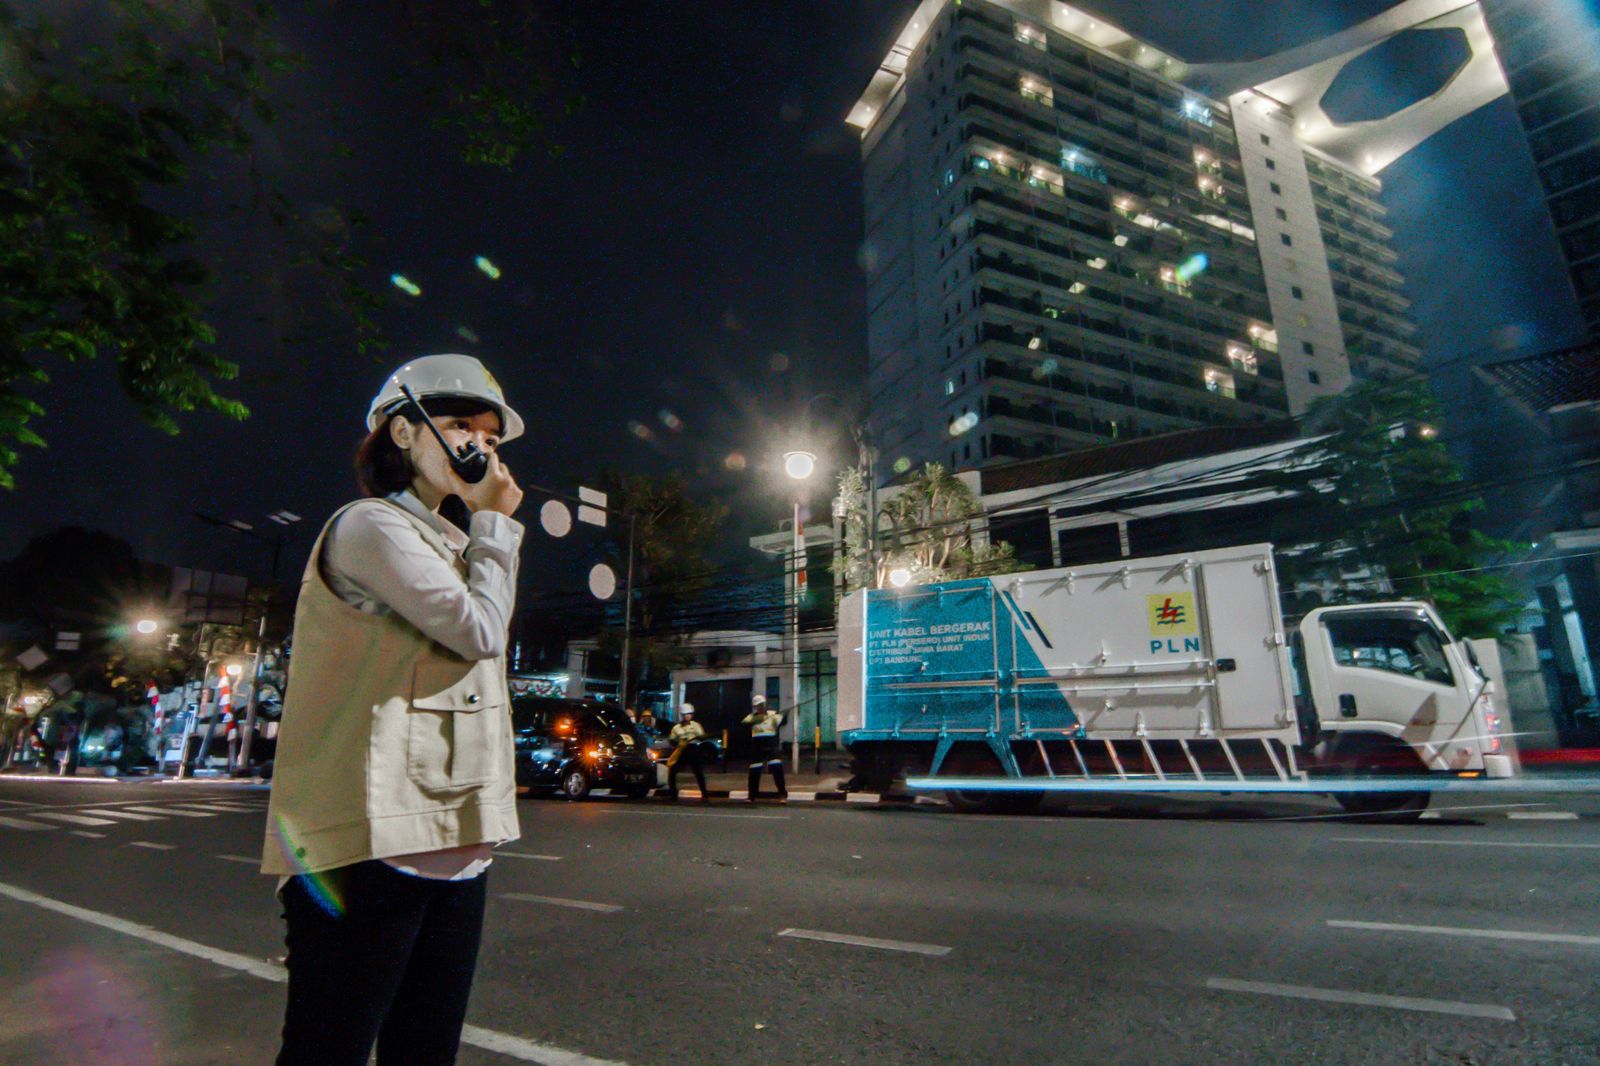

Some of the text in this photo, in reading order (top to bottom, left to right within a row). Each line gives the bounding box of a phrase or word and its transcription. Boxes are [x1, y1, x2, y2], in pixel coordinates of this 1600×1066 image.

[869, 622, 990, 639] UNIT KABEL BERGERAK
[942, 635, 961, 643] UNIT
[963, 633, 990, 641] INDUK
[1150, 637, 1200, 654] PLN
